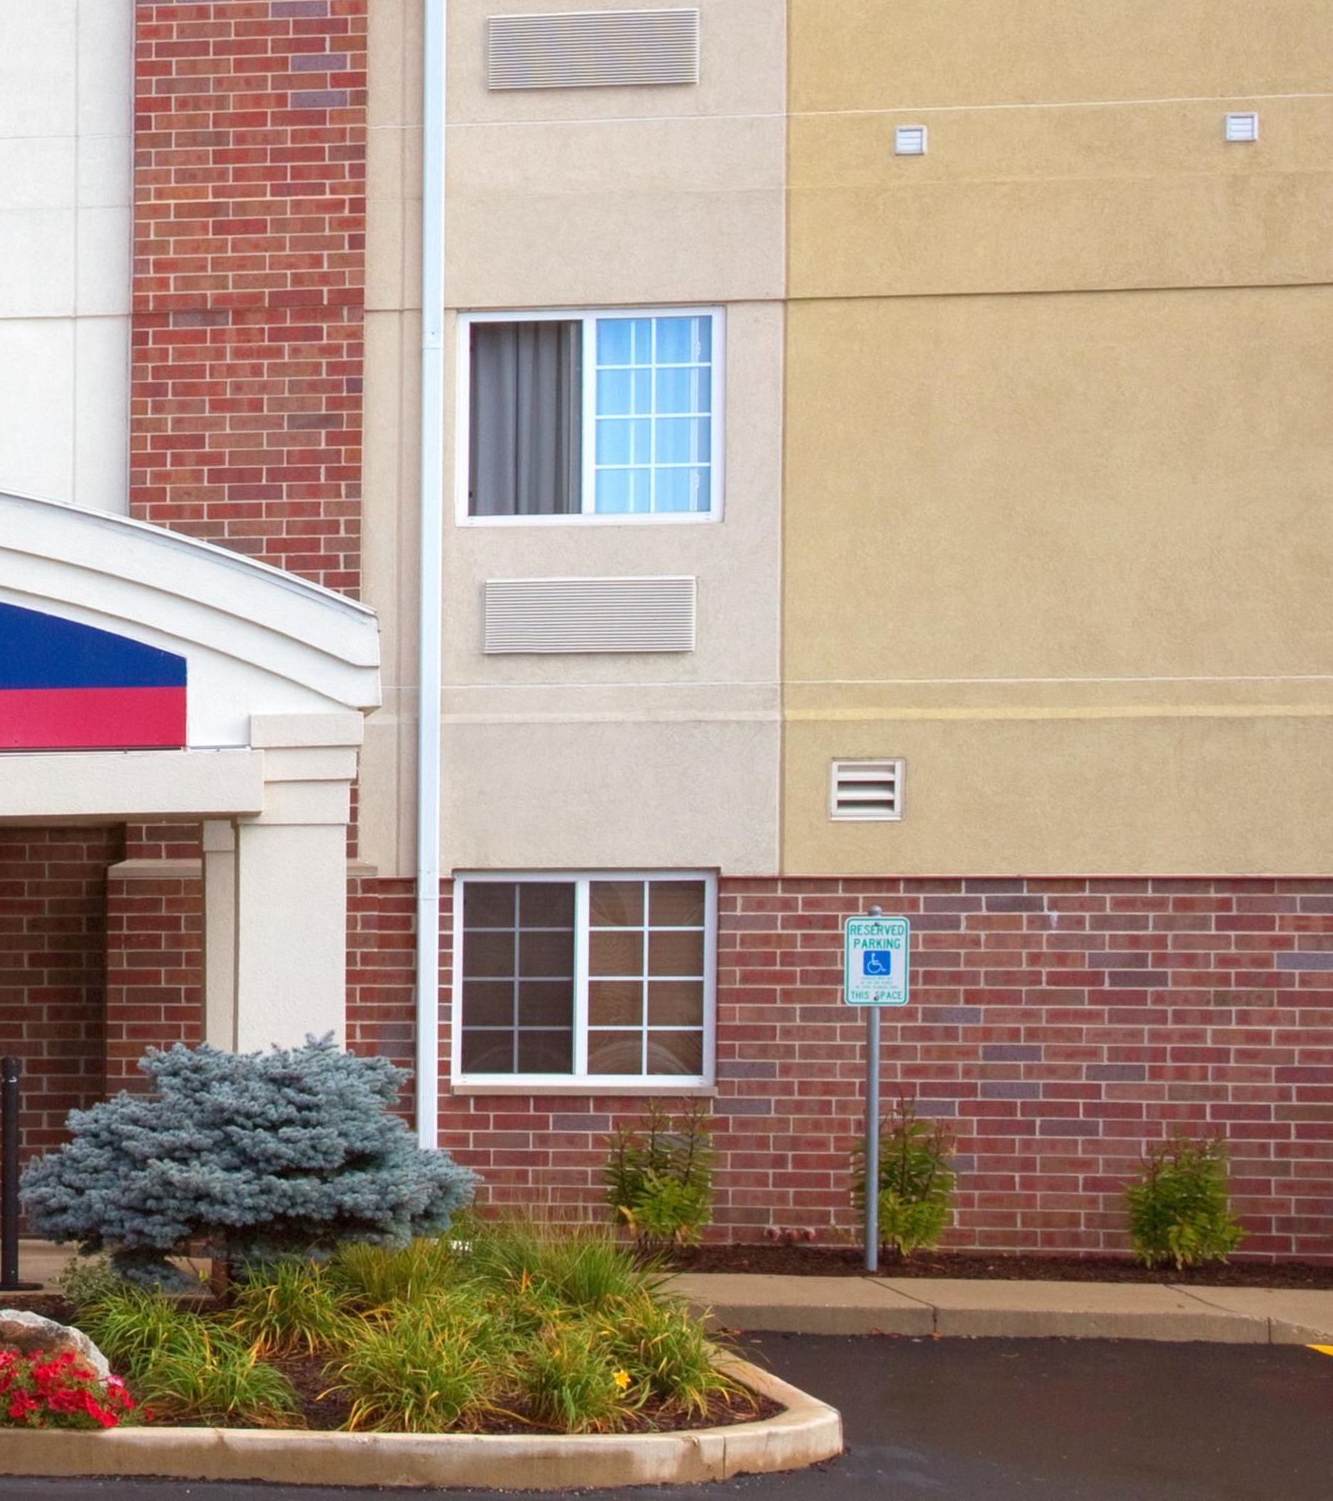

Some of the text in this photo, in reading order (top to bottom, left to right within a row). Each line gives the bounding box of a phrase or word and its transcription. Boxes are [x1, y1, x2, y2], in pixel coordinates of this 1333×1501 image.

[850, 924, 904, 936] RESERVED
[853, 938, 901, 949] PARKING
[851, 991, 902, 1000] THIS SPACE
